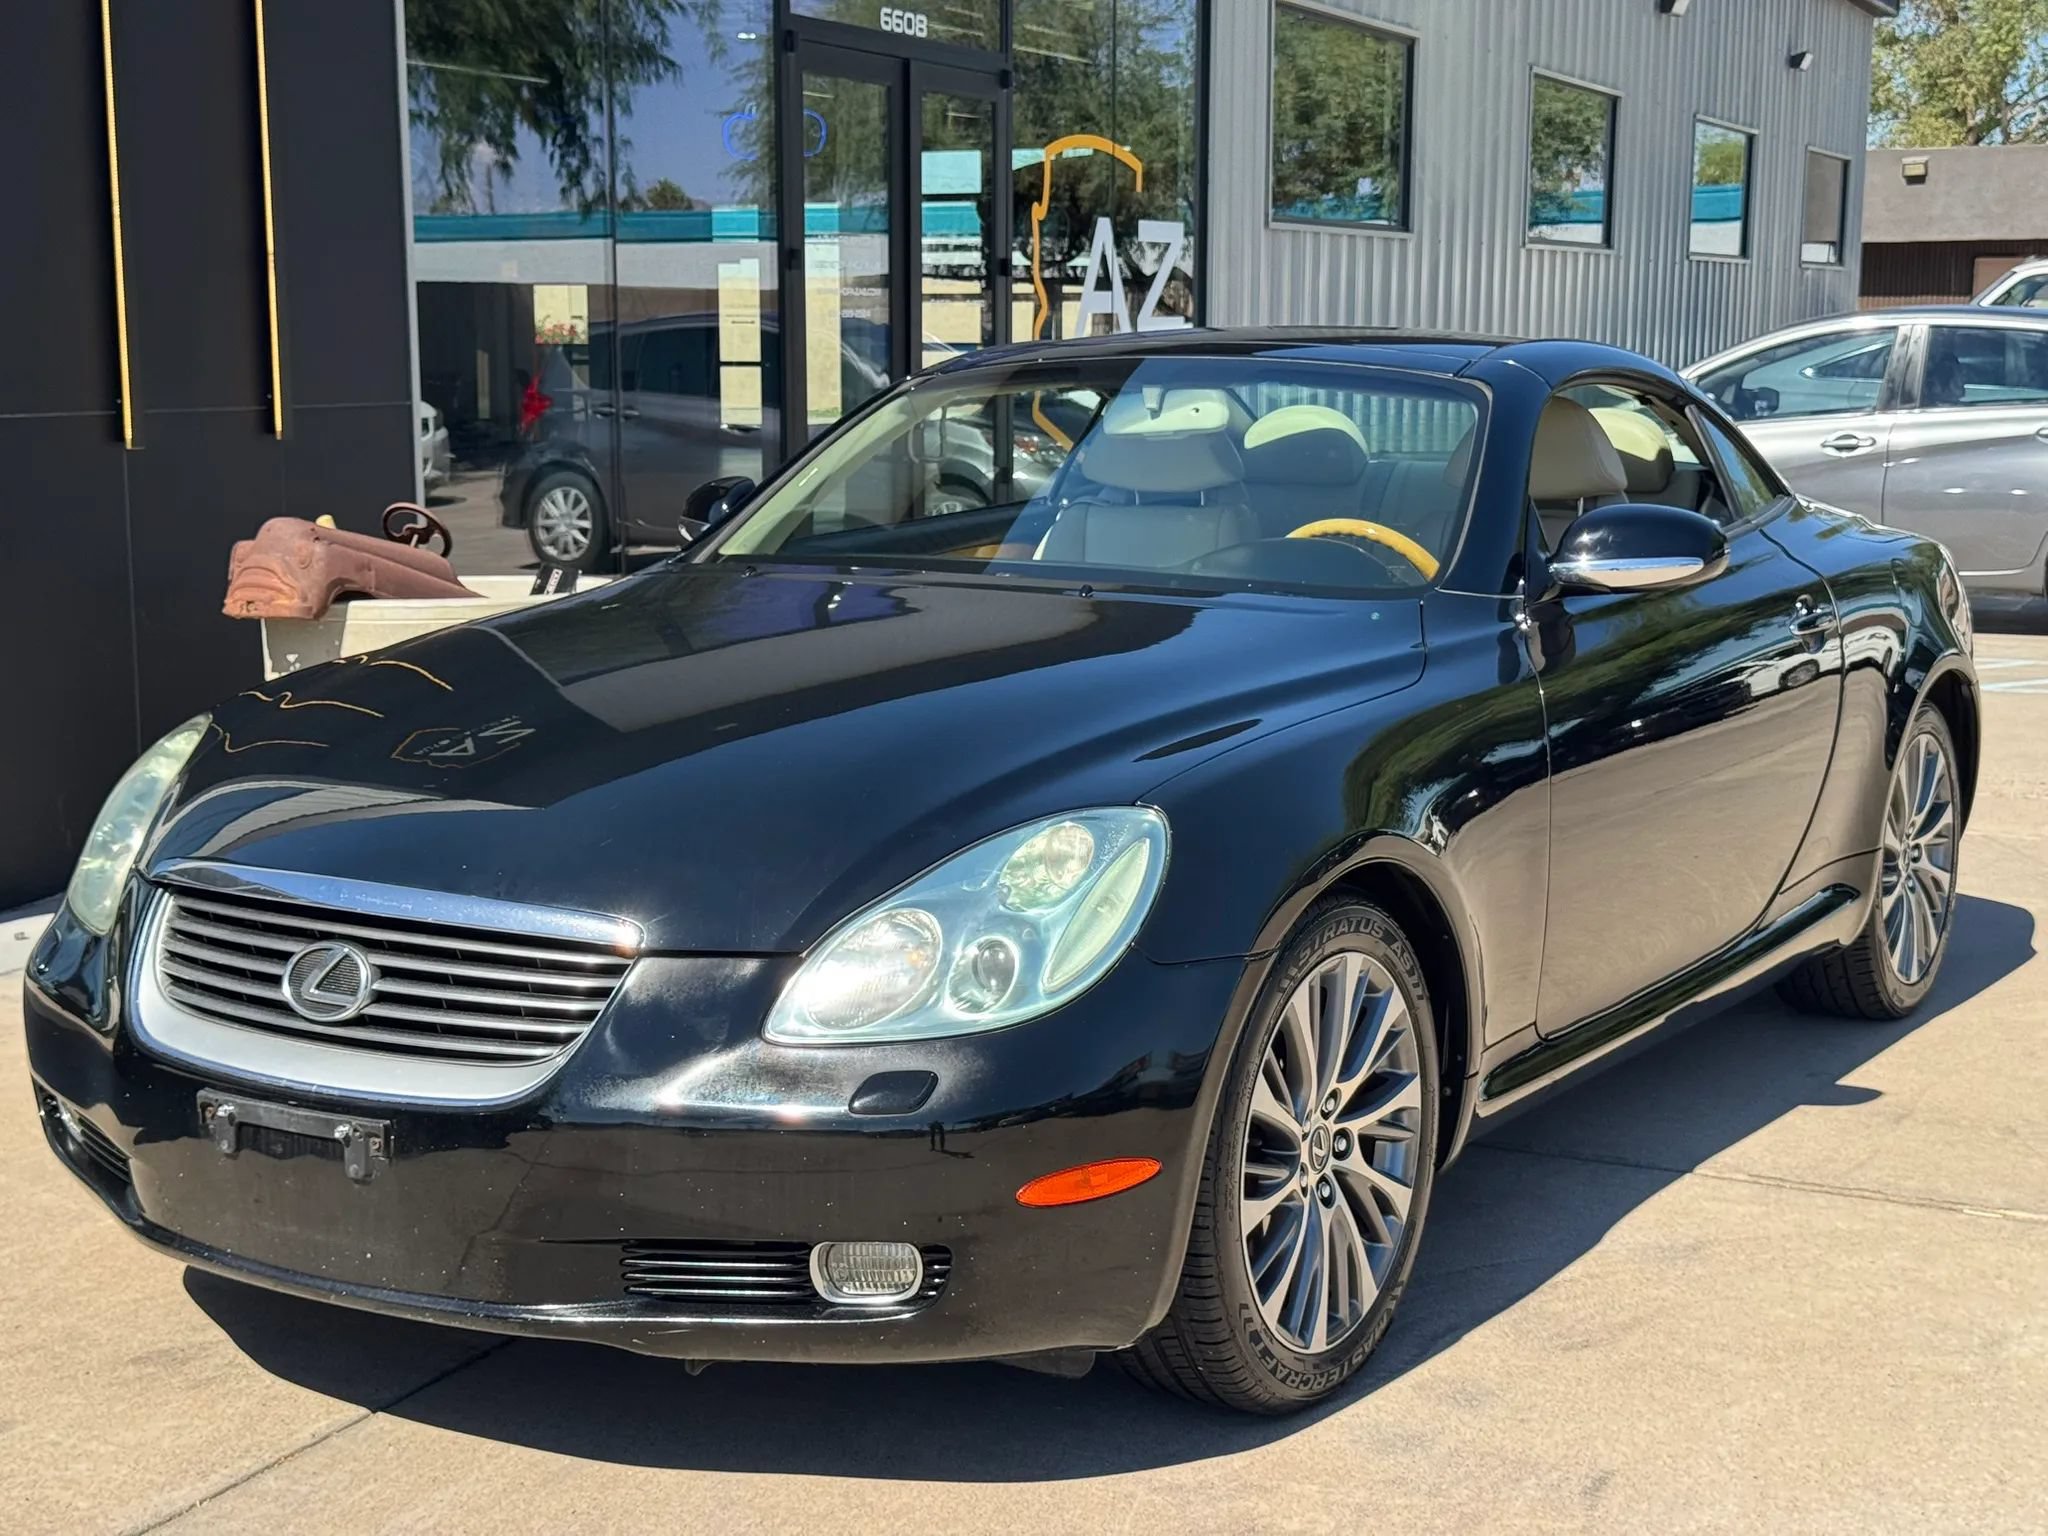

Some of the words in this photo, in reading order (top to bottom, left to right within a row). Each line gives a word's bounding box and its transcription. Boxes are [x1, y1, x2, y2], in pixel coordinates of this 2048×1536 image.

[880, 7, 928, 38] 6608
[1075, 216, 1185, 338] AZ
[1299, 916, 1385, 967] STRATUS
[1249, 1308, 1392, 1391] MASTERCRAFT
